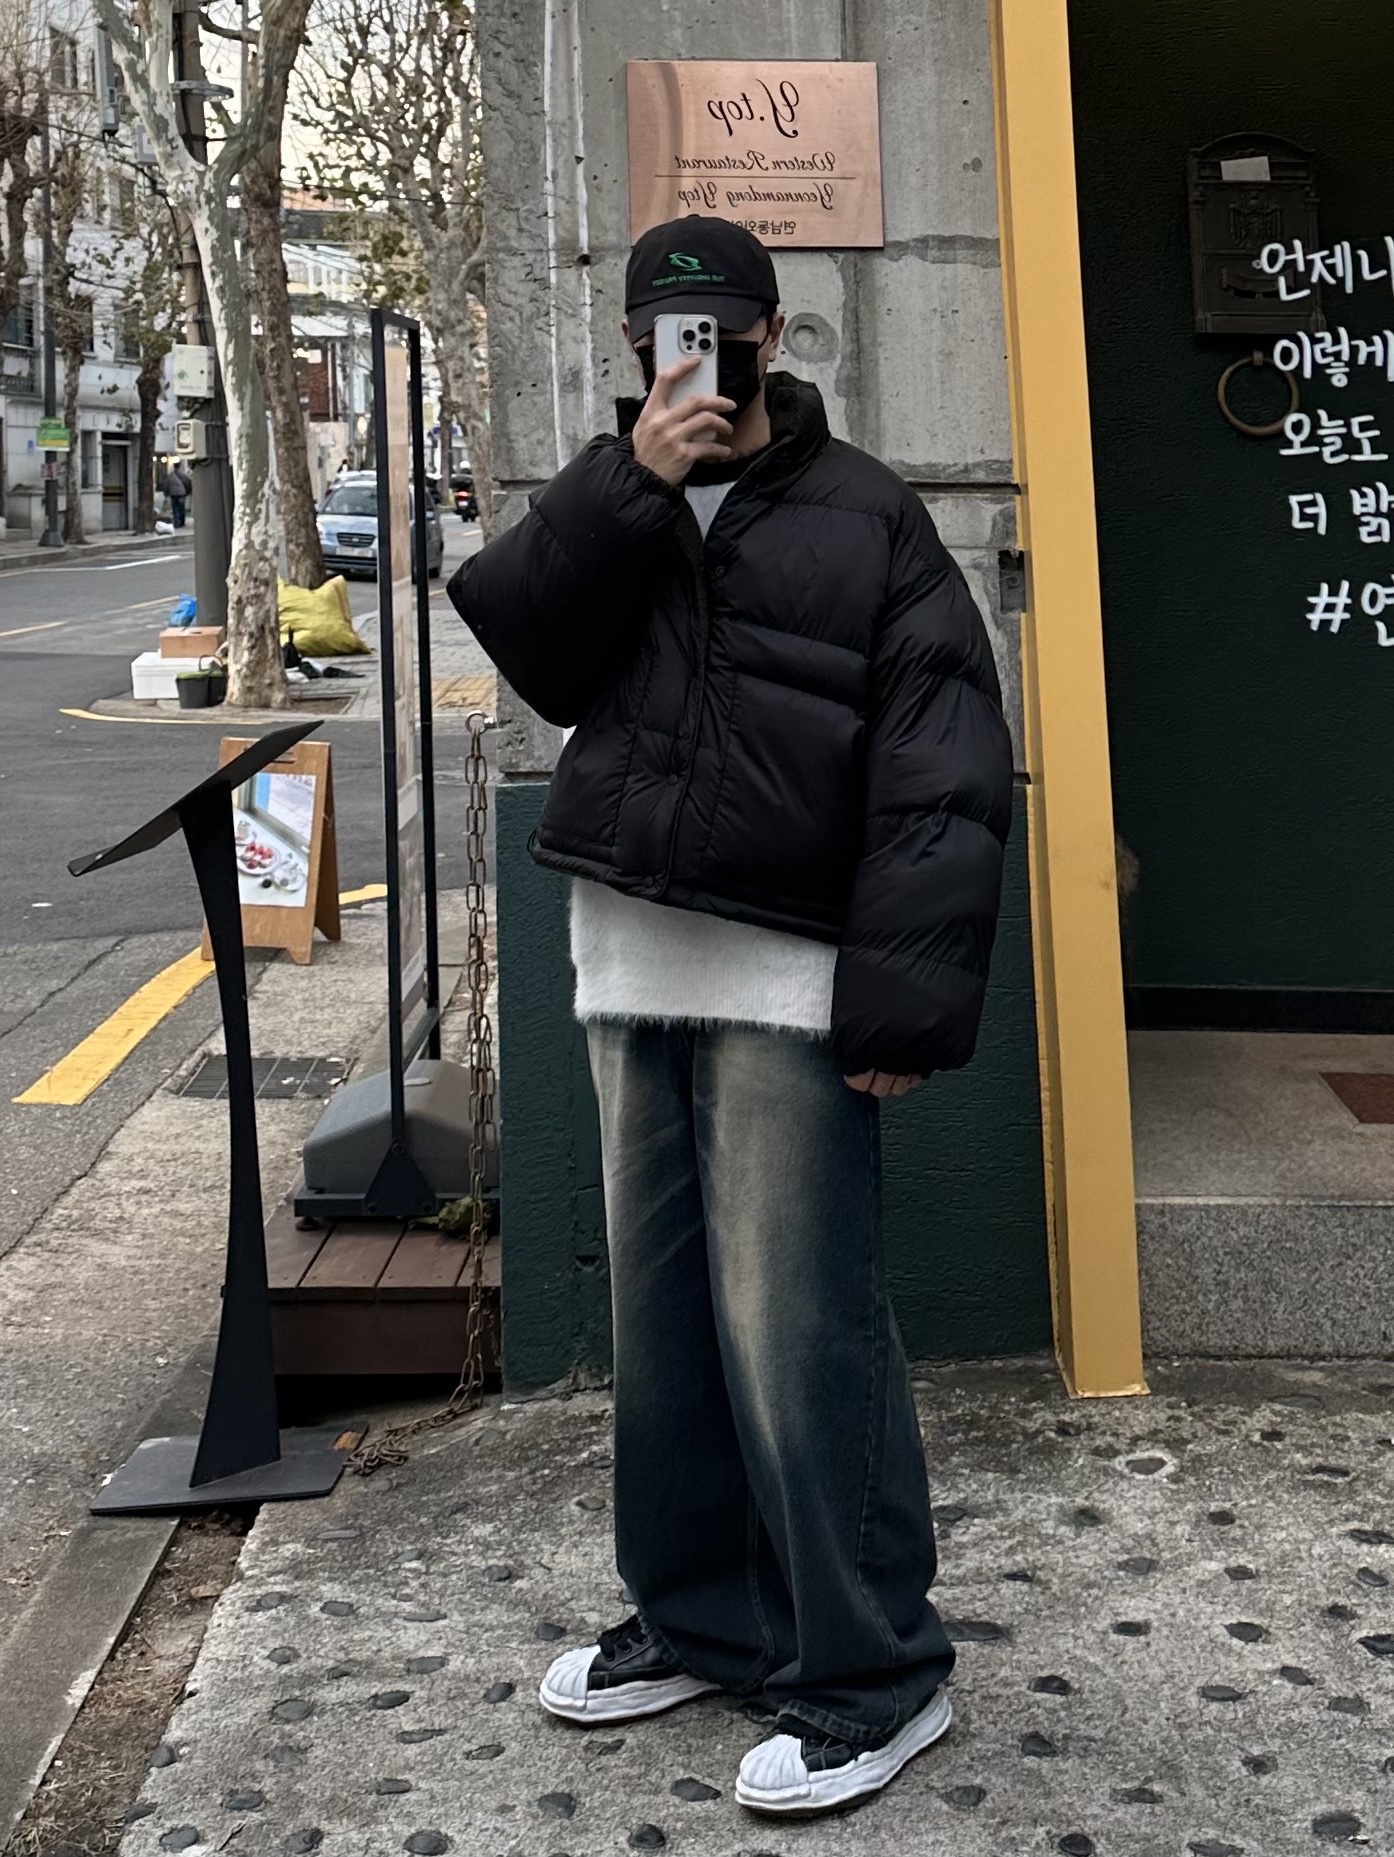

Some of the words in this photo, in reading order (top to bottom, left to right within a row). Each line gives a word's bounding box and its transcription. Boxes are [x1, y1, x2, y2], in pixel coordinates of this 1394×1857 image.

[1273, 326, 1394, 388] 이렇게
[1279, 409, 1389, 464] 오늘도
[1288, 492, 1327, 536] 더
[1349, 481, 1394, 544] 밝
